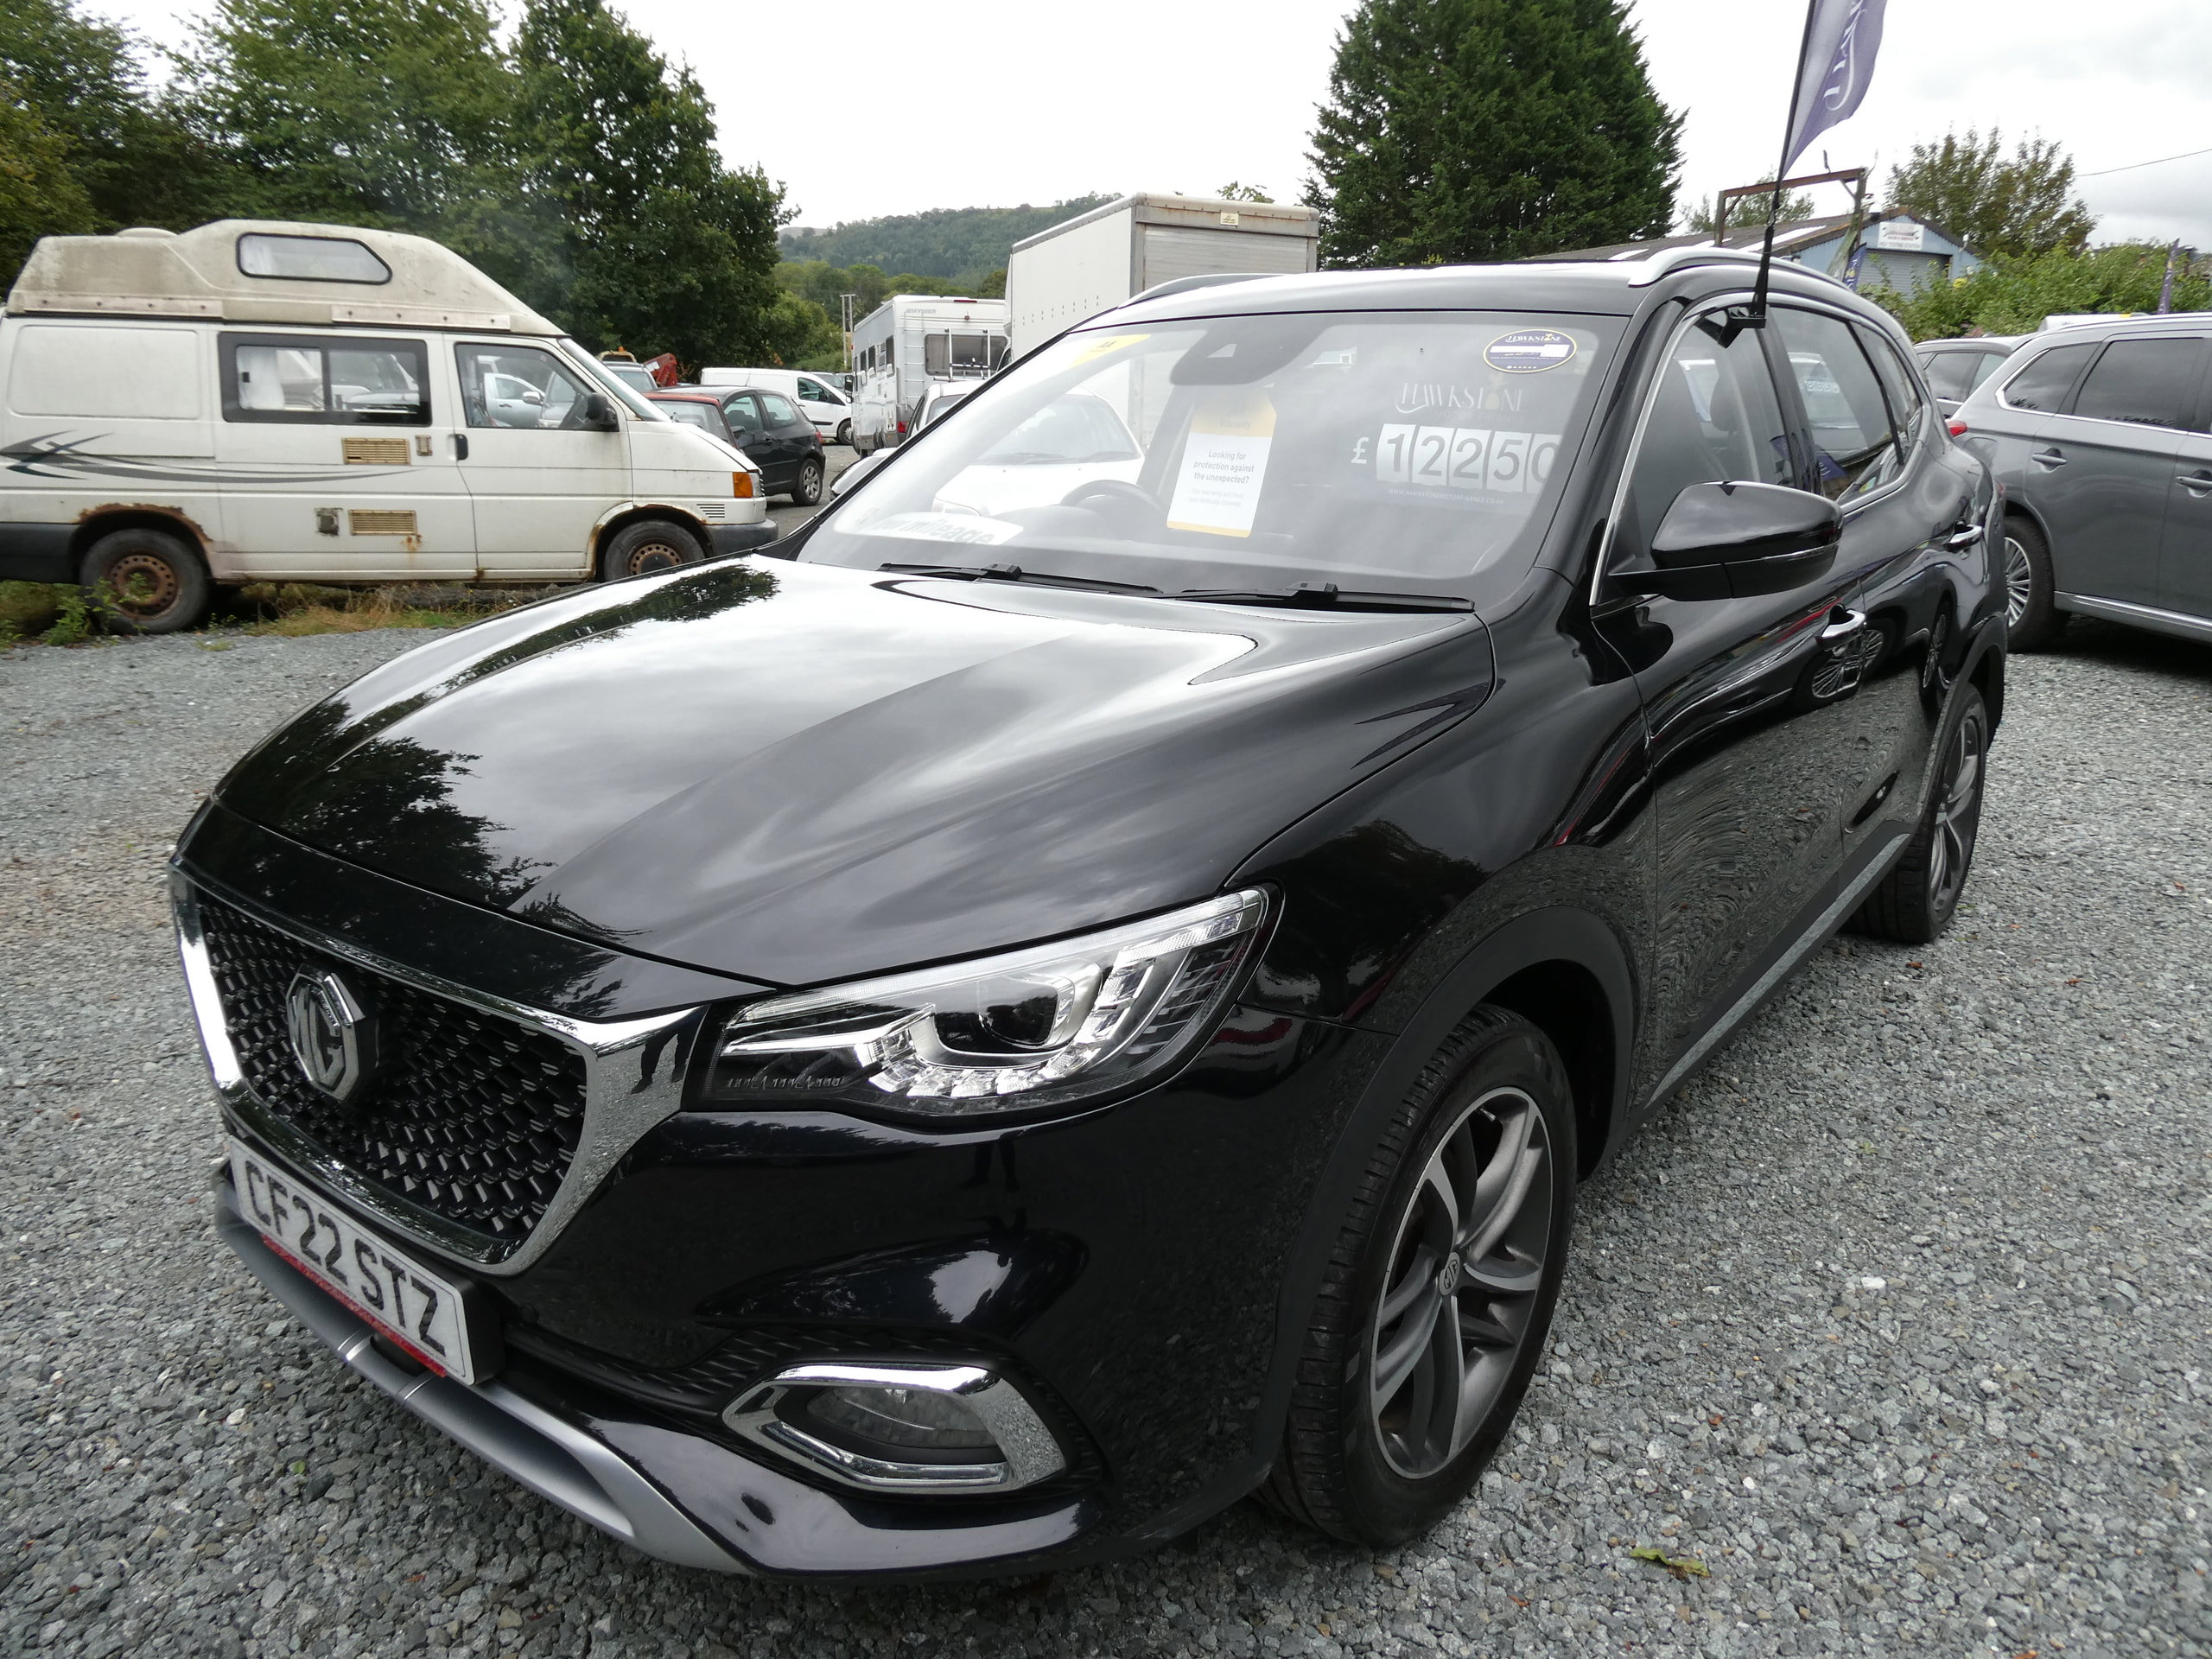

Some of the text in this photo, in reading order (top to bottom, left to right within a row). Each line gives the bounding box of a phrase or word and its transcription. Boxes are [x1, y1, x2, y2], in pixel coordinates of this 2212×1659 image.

[1219, 421, 1251, 430] Warranty
[1208, 450, 1247, 461] Looking for
[1350, 433, 1558, 484] £ 12250
[1193, 461, 1255, 474] protection against
[1193, 472, 1249, 485] the unexpected?
[245, 1159, 446, 1357] CF22 STZ
